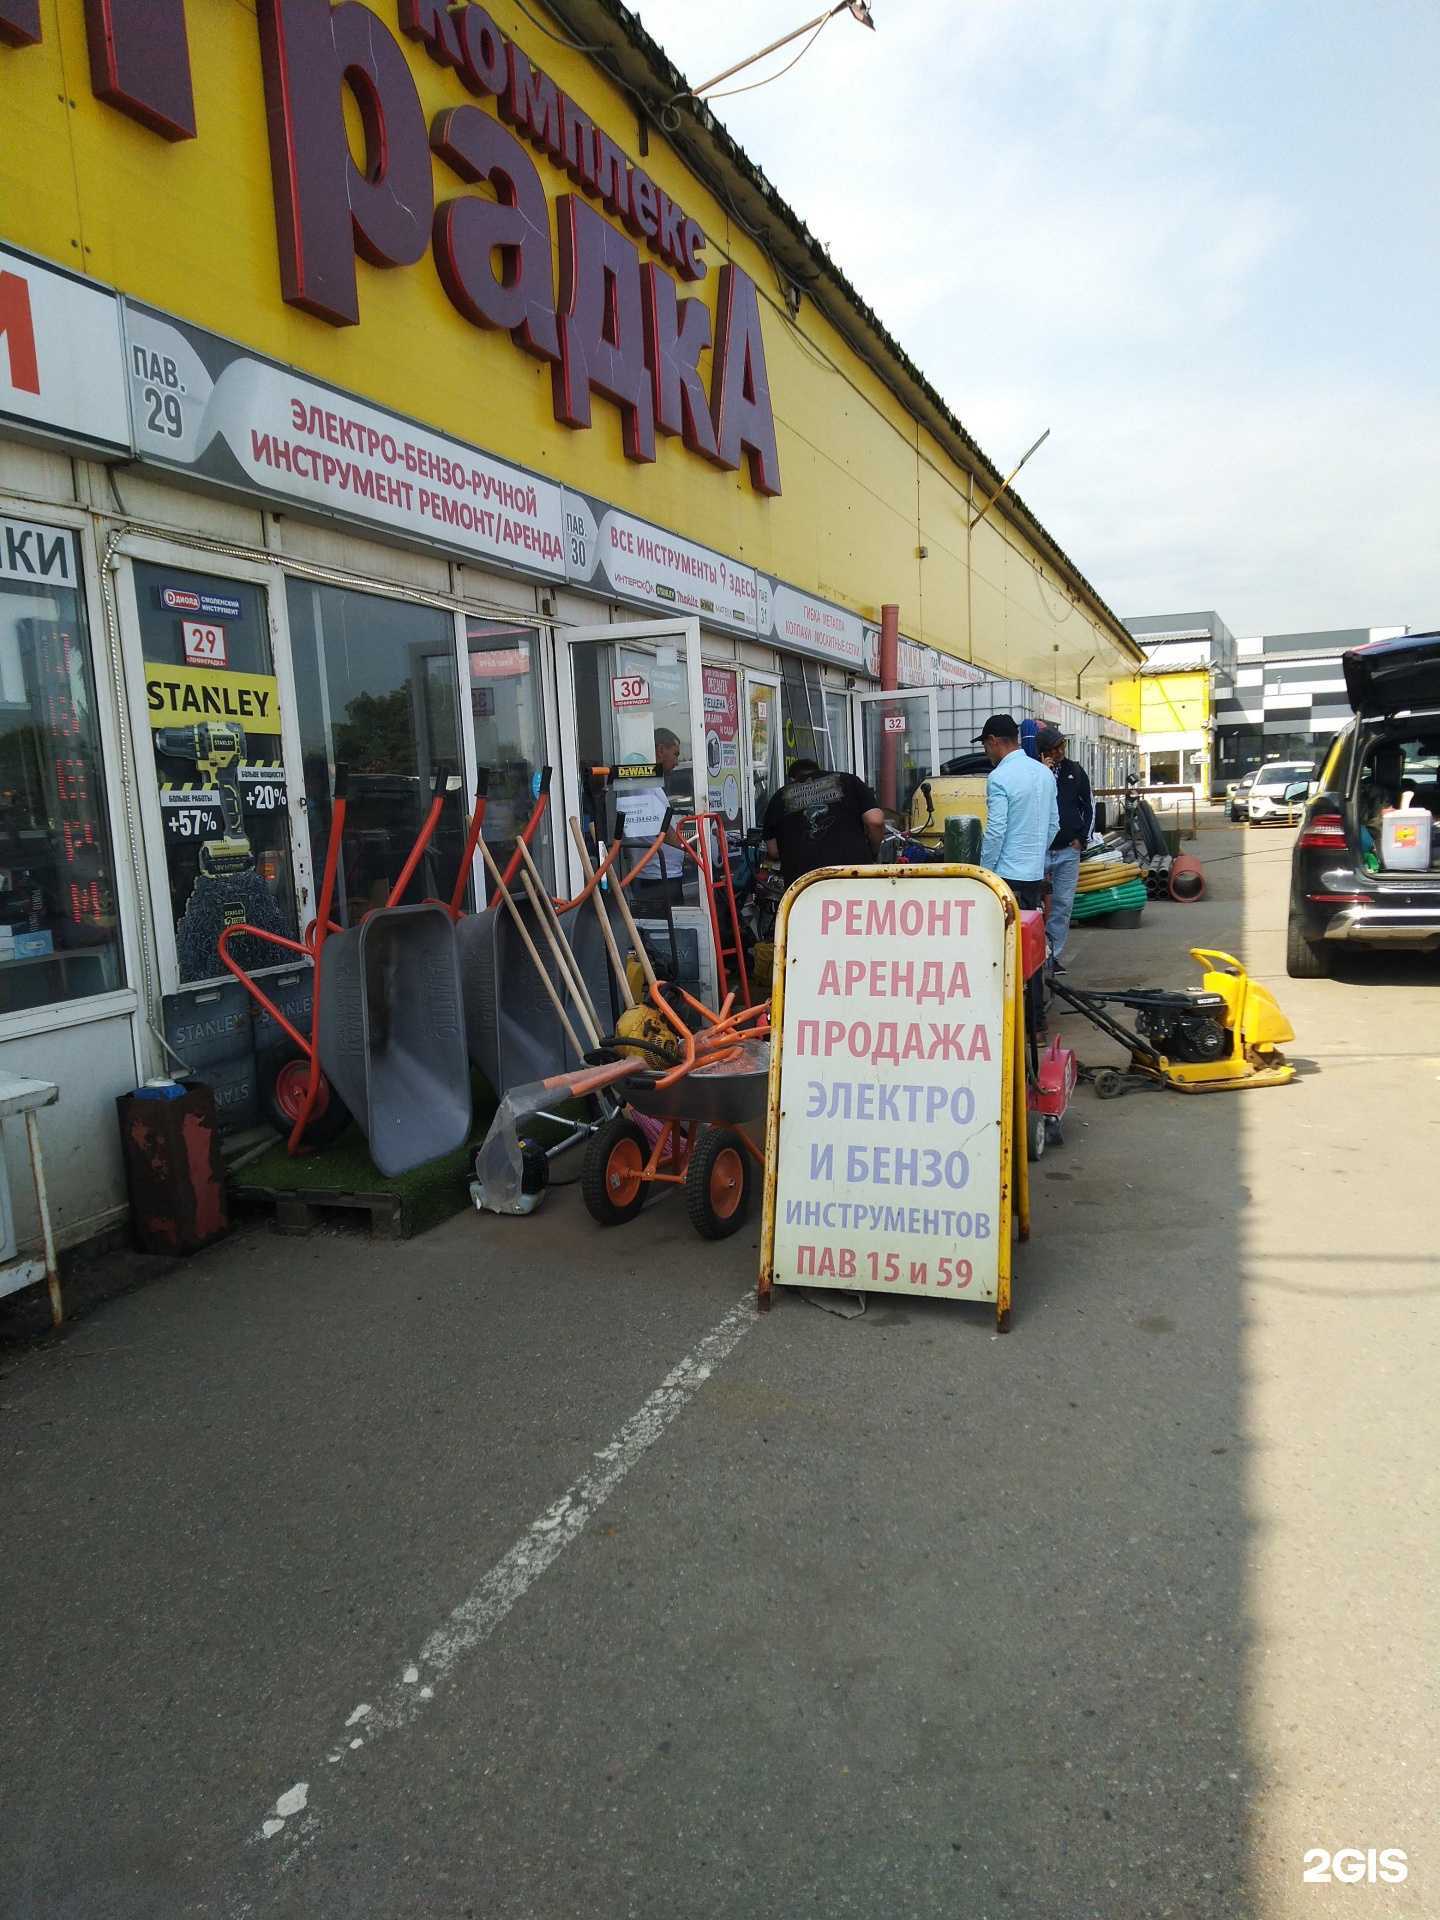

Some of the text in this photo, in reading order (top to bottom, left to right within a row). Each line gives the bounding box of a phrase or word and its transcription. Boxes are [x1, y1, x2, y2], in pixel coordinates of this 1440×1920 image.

[132, 345, 186, 393] ПАВ.
[144, 387, 183, 438] 29
[290, 398, 538, 517] ЭЛЕКТРО-БЕНЗО-РУЧНОЙ
[251, 429, 564, 562] ИНСТРУМЕНТ РЕМОНТ/АРЕНДА
[0, 526, 68, 580] КИ
[571, 537, 586, 567] 30
[610, 526, 757, 600] ВСЕ ИНСТРУМЕНТЫ ЗДЕСЬ
[192, 628, 216, 653] 29
[146, 681, 269, 718] STANLEY
[621, 680, 642, 698] 30
[889, 718, 902, 729] 32
[246, 785, 287, 810] +20%
[168, 809, 217, 836] +57%
[820, 899, 976, 936] РЕМОНТ
[817, 959, 972, 1005] АРЕНДА
[796, 1019, 992, 1066] ПРОДАЖА
[806, 1081, 976, 1125] ЭЛЕКТРО
[810, 1143, 970, 1189] И БЕНЗО
[785, 1200, 991, 1239] ИНСТРУМЕНТОВ
[797, 1245, 973, 1289] ПАВ 15 и 59
